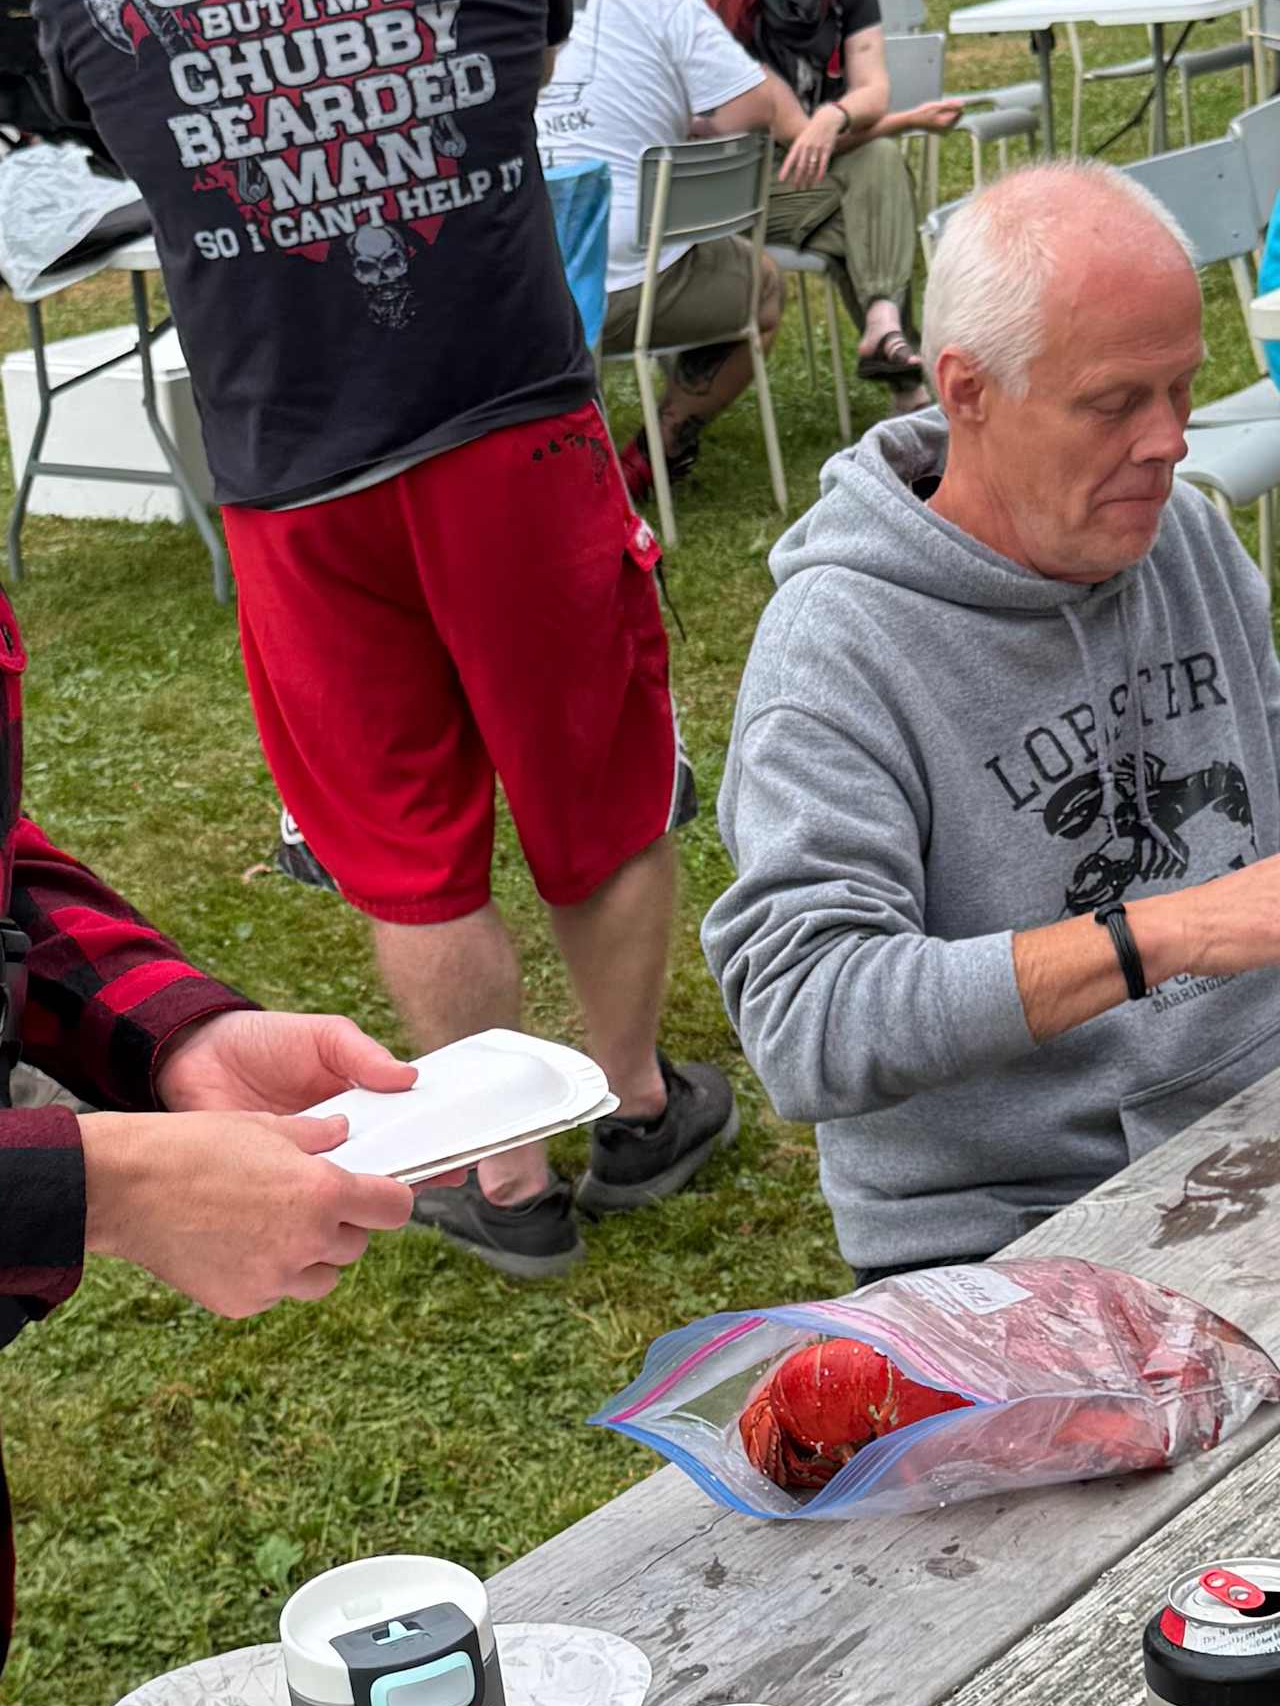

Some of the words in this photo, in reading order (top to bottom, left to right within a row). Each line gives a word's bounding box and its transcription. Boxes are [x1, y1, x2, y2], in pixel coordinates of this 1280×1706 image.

[166, 52, 497, 170] BEARDED
[193, 226, 240, 261] SO
[269, 195, 387, 249] CAN'T
[394, 167, 494, 222] HELP
[498, 157, 525, 192] IT
[261, 124, 437, 212] MAN
